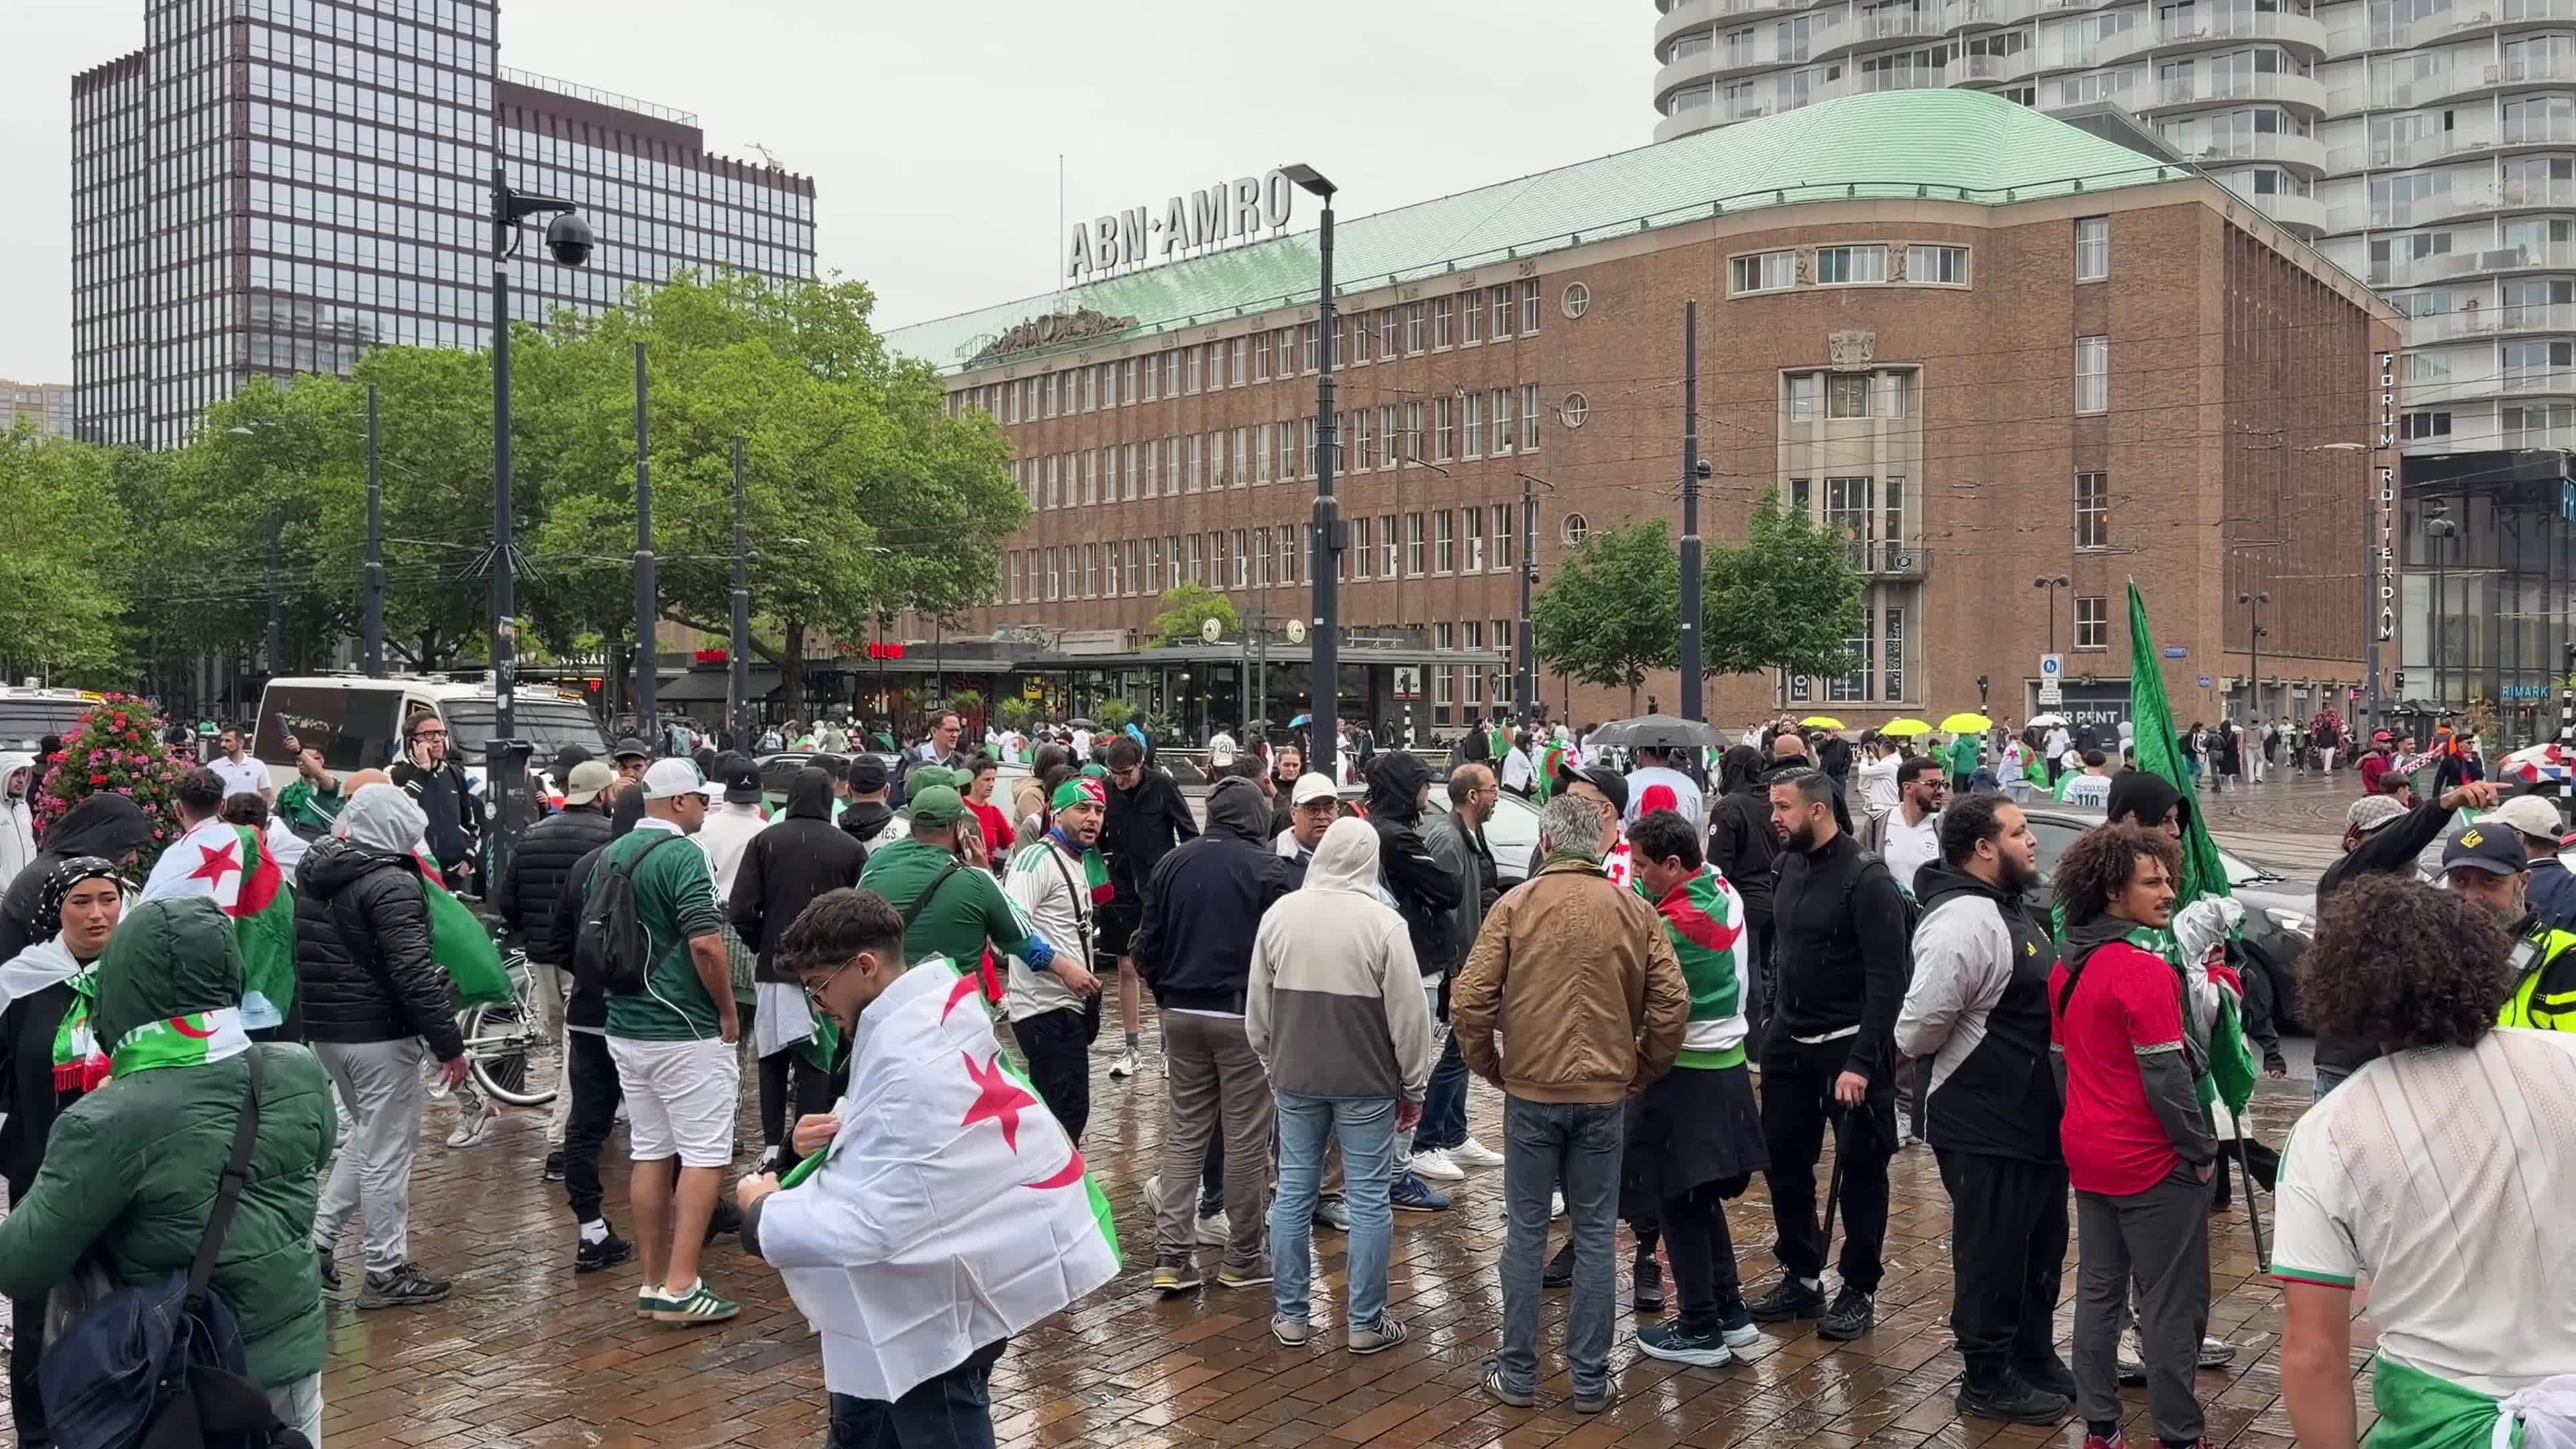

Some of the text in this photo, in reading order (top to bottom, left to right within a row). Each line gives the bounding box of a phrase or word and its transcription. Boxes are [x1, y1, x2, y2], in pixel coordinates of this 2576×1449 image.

[1067, 168, 1292, 278] ABN AMRO
[2381, 354, 2394, 637] FORUM ROTTERDAM
[1220, 741, 1231, 753] 20
[2042, 711, 2118, 724] FR RENT
